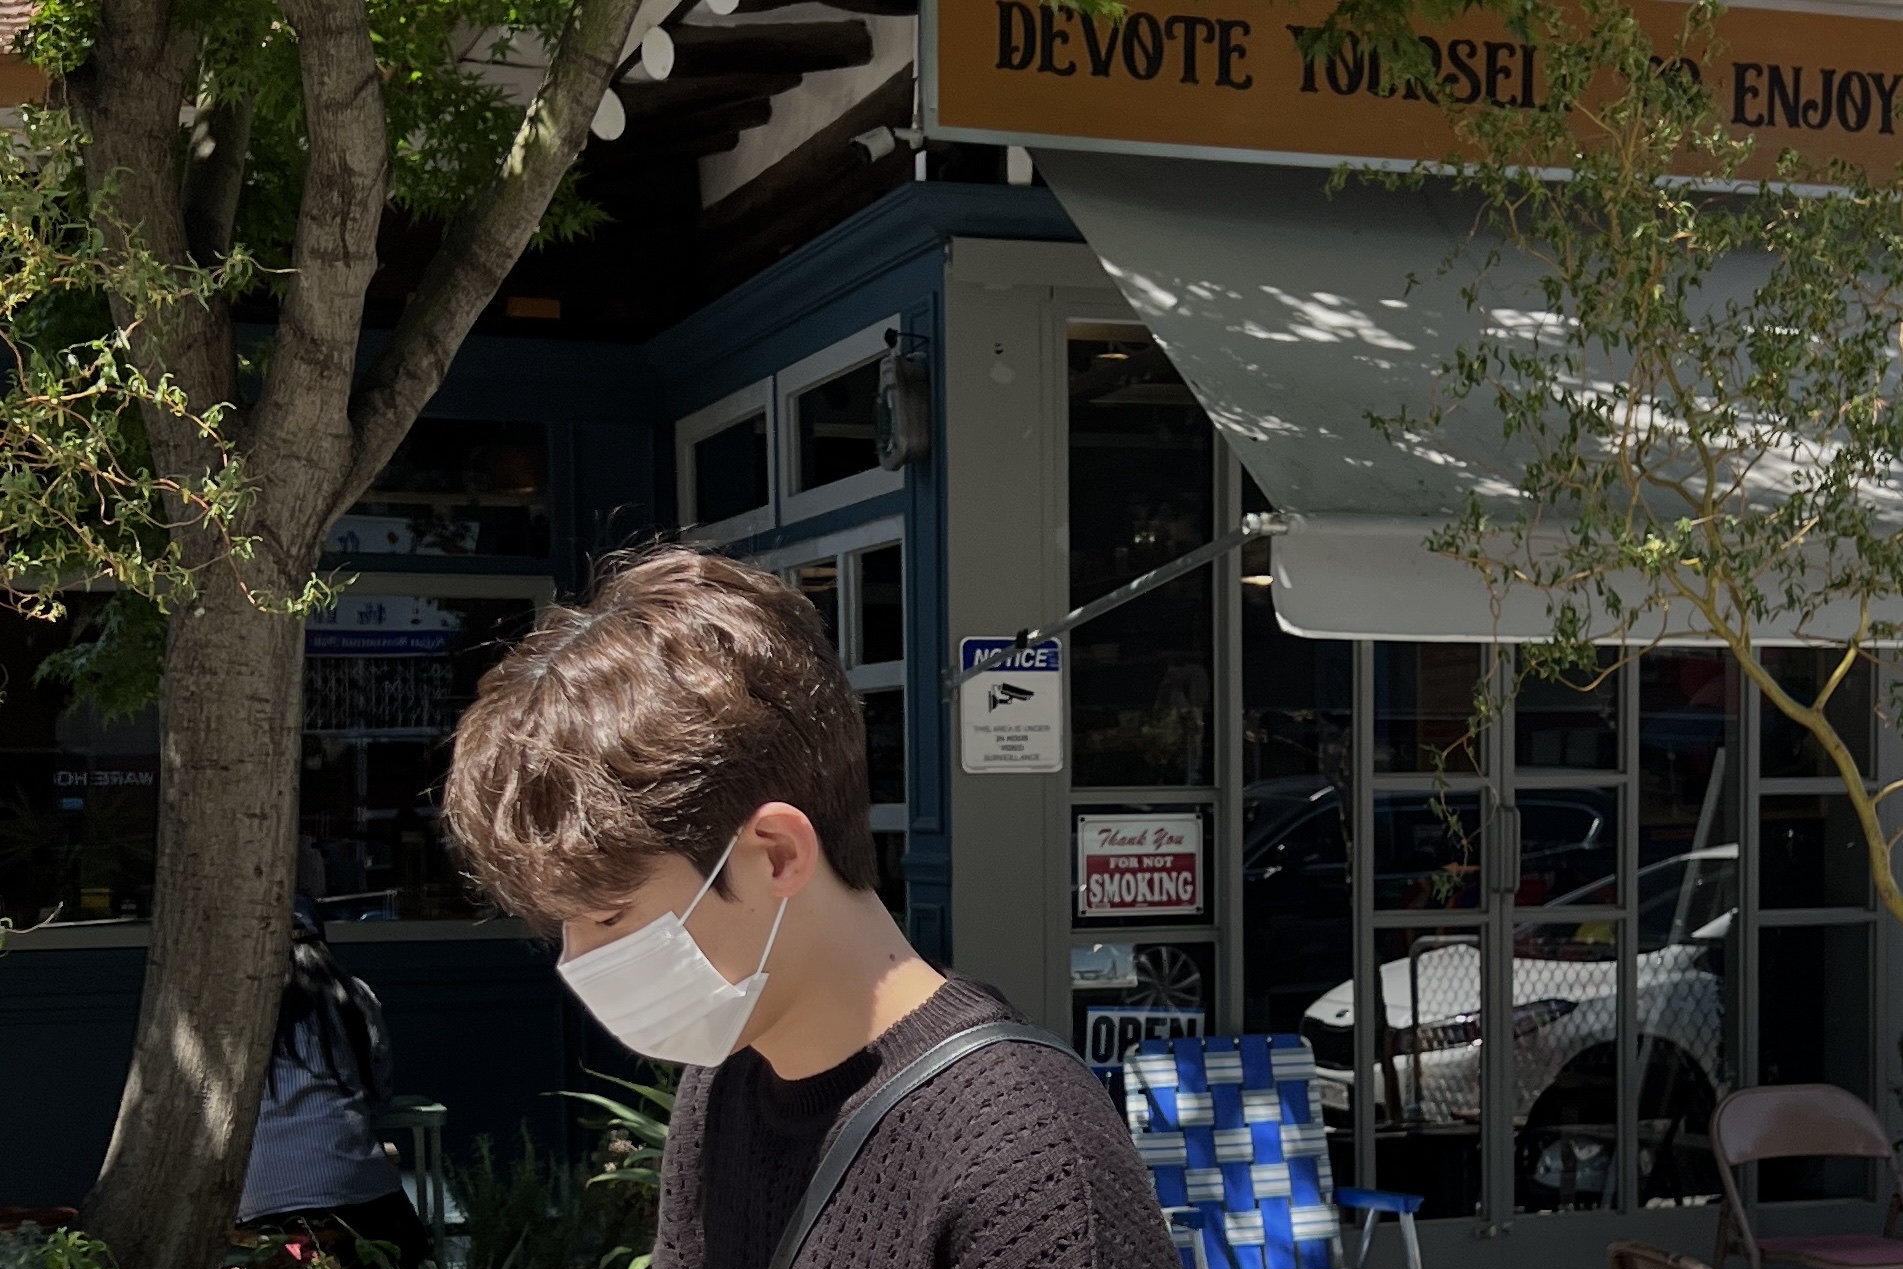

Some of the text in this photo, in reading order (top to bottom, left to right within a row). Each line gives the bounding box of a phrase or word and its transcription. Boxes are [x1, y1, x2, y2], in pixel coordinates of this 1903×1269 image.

[996, 1, 1253, 90] DEVOTE
[1731, 61, 1903, 134] ENJOY
[1097, 827, 1185, 850] Thank You
[1109, 855, 1174, 869] FOR NOT
[1089, 870, 1194, 904] SMOKING
